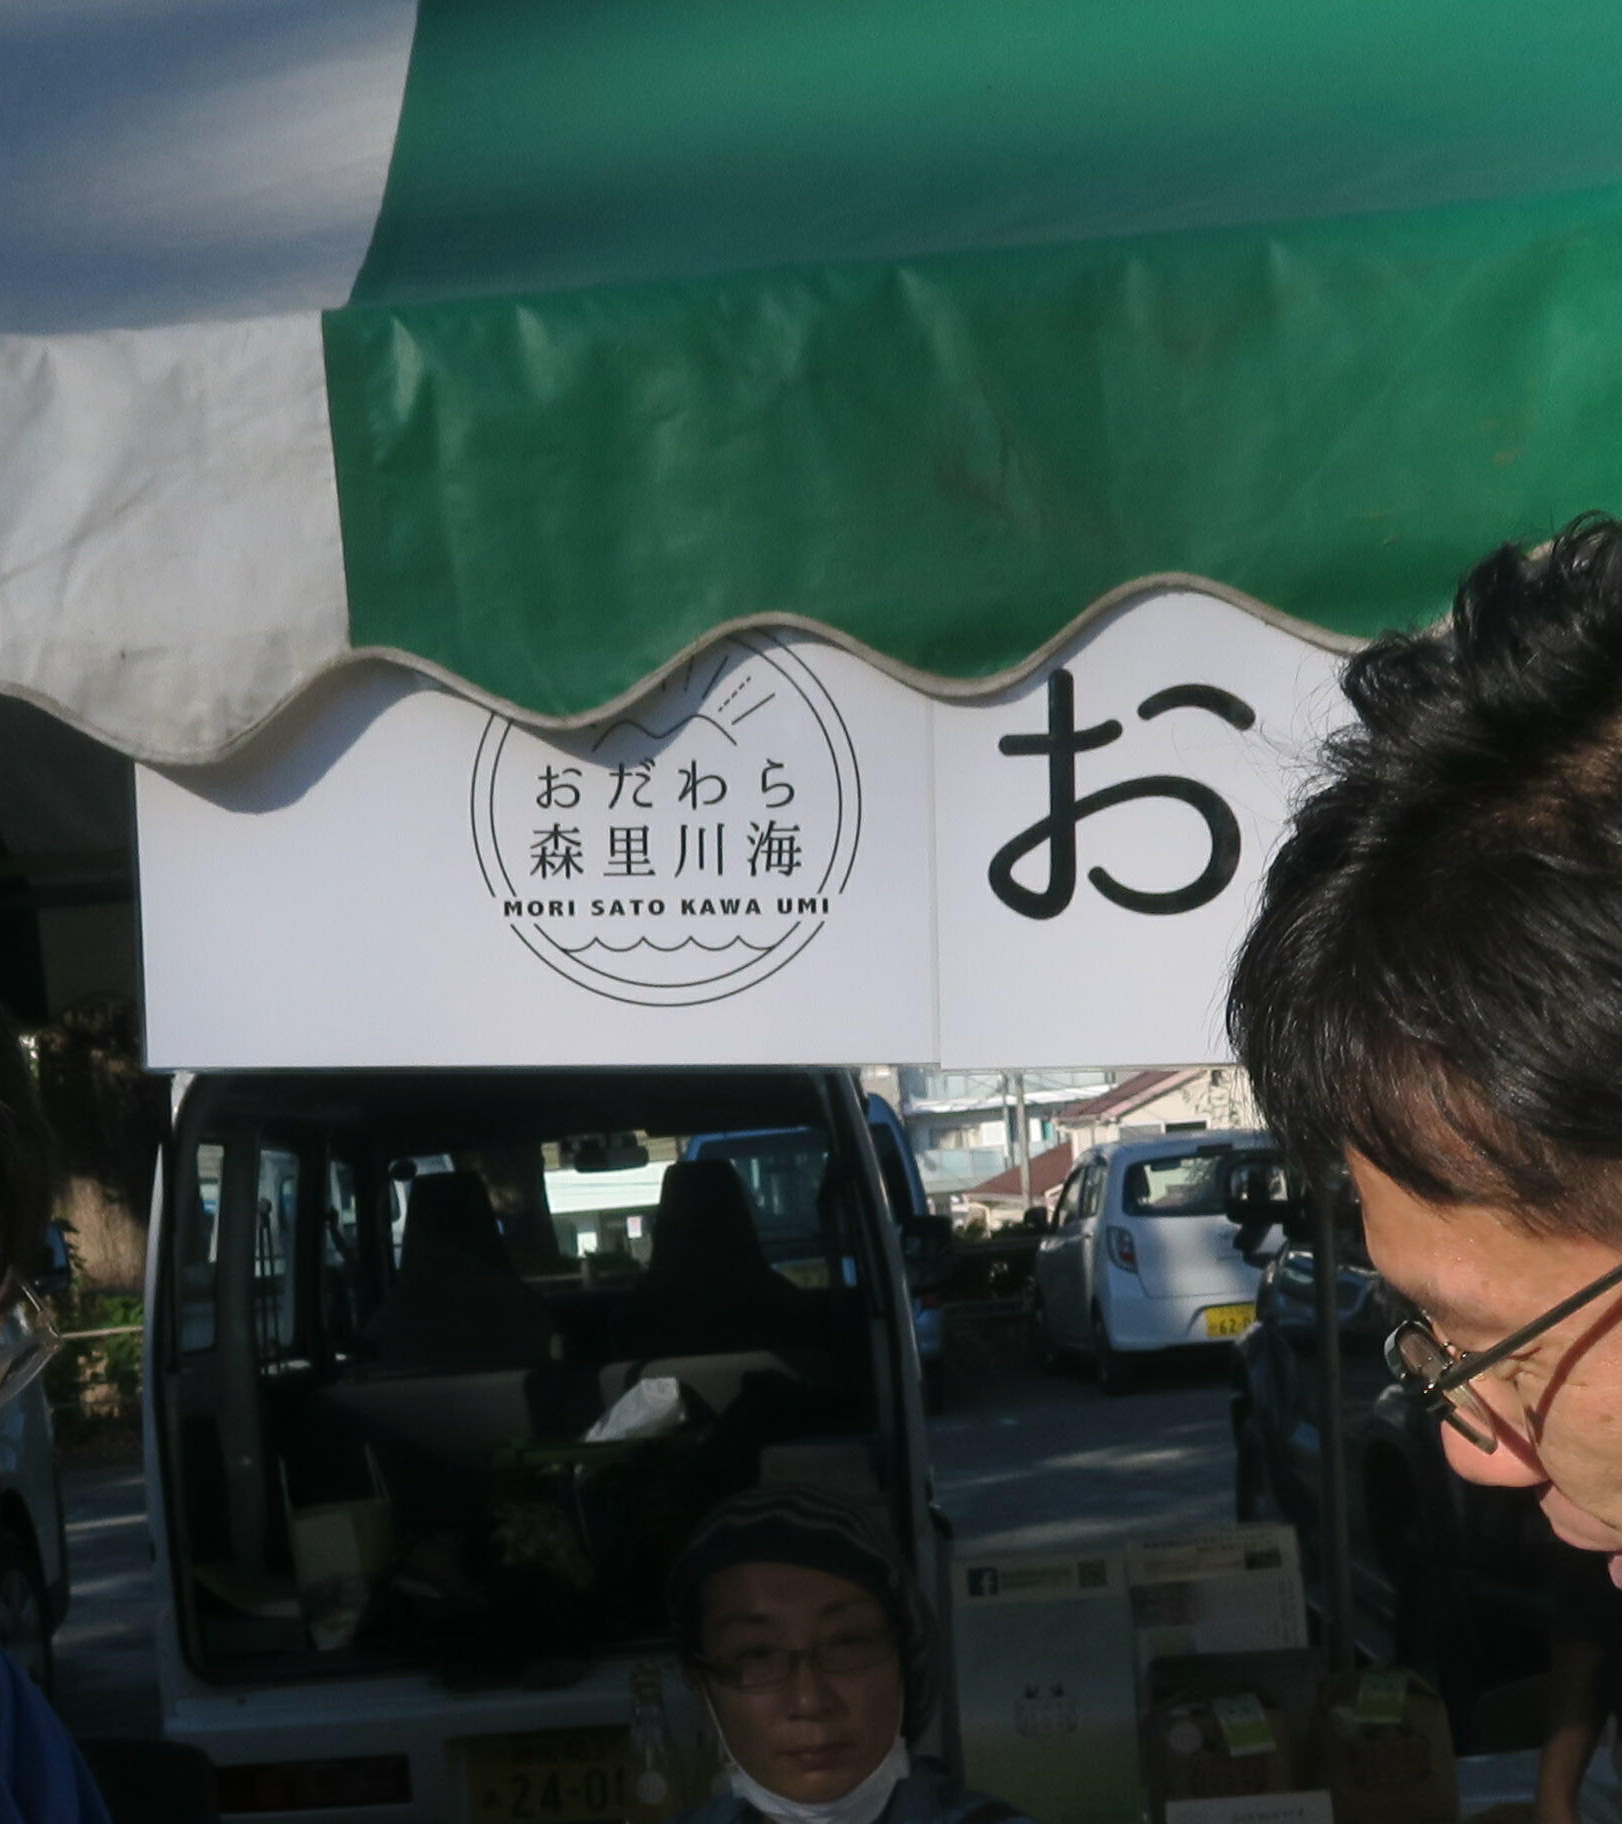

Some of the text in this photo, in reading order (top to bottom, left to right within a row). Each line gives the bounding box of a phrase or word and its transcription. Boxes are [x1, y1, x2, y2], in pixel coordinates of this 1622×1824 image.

[536, 757, 795, 811] おだわら
[529, 820, 803, 880] 森里川海
[504, 896, 830, 917] MORI SATO KAWA UMI
